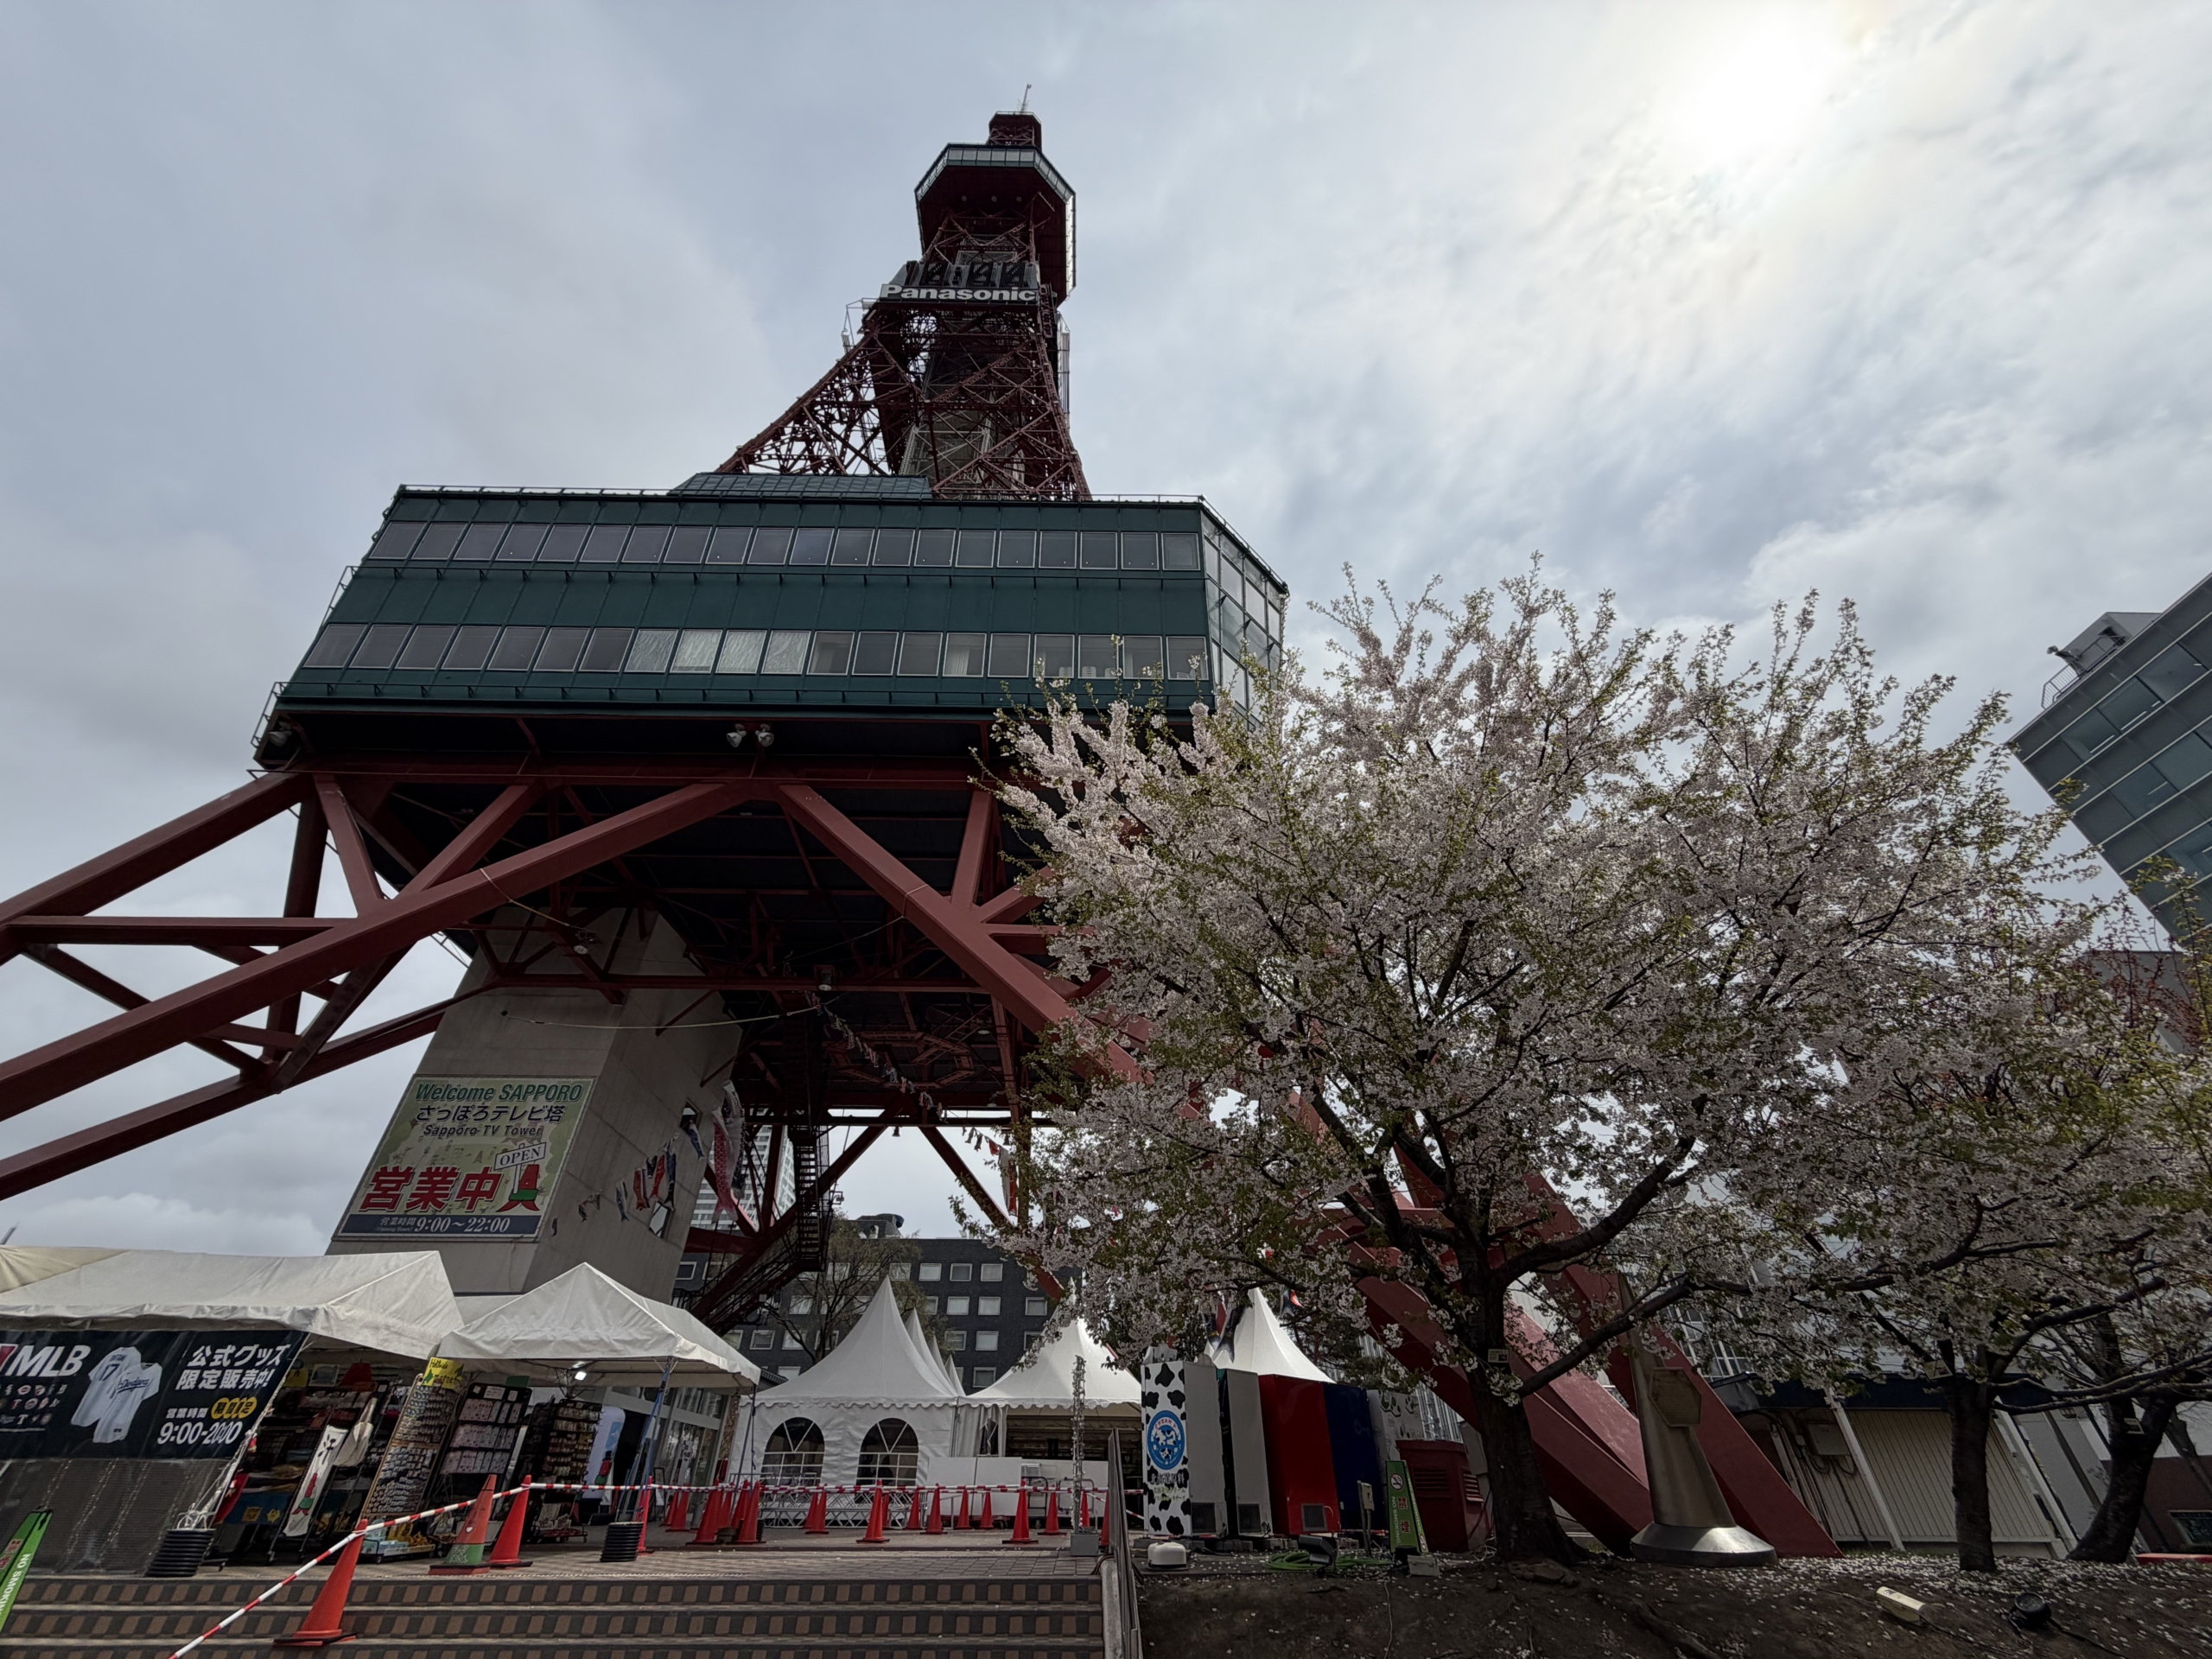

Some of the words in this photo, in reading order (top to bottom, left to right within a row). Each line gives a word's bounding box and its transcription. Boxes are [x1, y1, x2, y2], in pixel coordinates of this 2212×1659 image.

[884, 285, 1035, 301] Panasonic
[416, 1084, 495, 1101] Welcome
[499, 1084, 582, 1101] SAPPORO
[416, 1105, 565, 1122] さっぽろテレビ塔
[423, 1125, 477, 1136] Sapporo
[484, 1125, 501, 1135] TV
[505, 1125, 543, 1136] Tower
[499, 1147, 542, 1166] OPEN
[359, 1166, 503, 1211] 営業中
[4, 1344, 91, 1376] MLB
[188, 1344, 290, 1366] 公式グッズ
[99, 1363, 120, 1382] 17
[175, 1369, 276, 1389] 限定販売中!
[1391, 1497, 1396, 1507] NO
[17, 1554, 30, 1568] NO
[0, 1571, 22, 1613] SMOKIN
